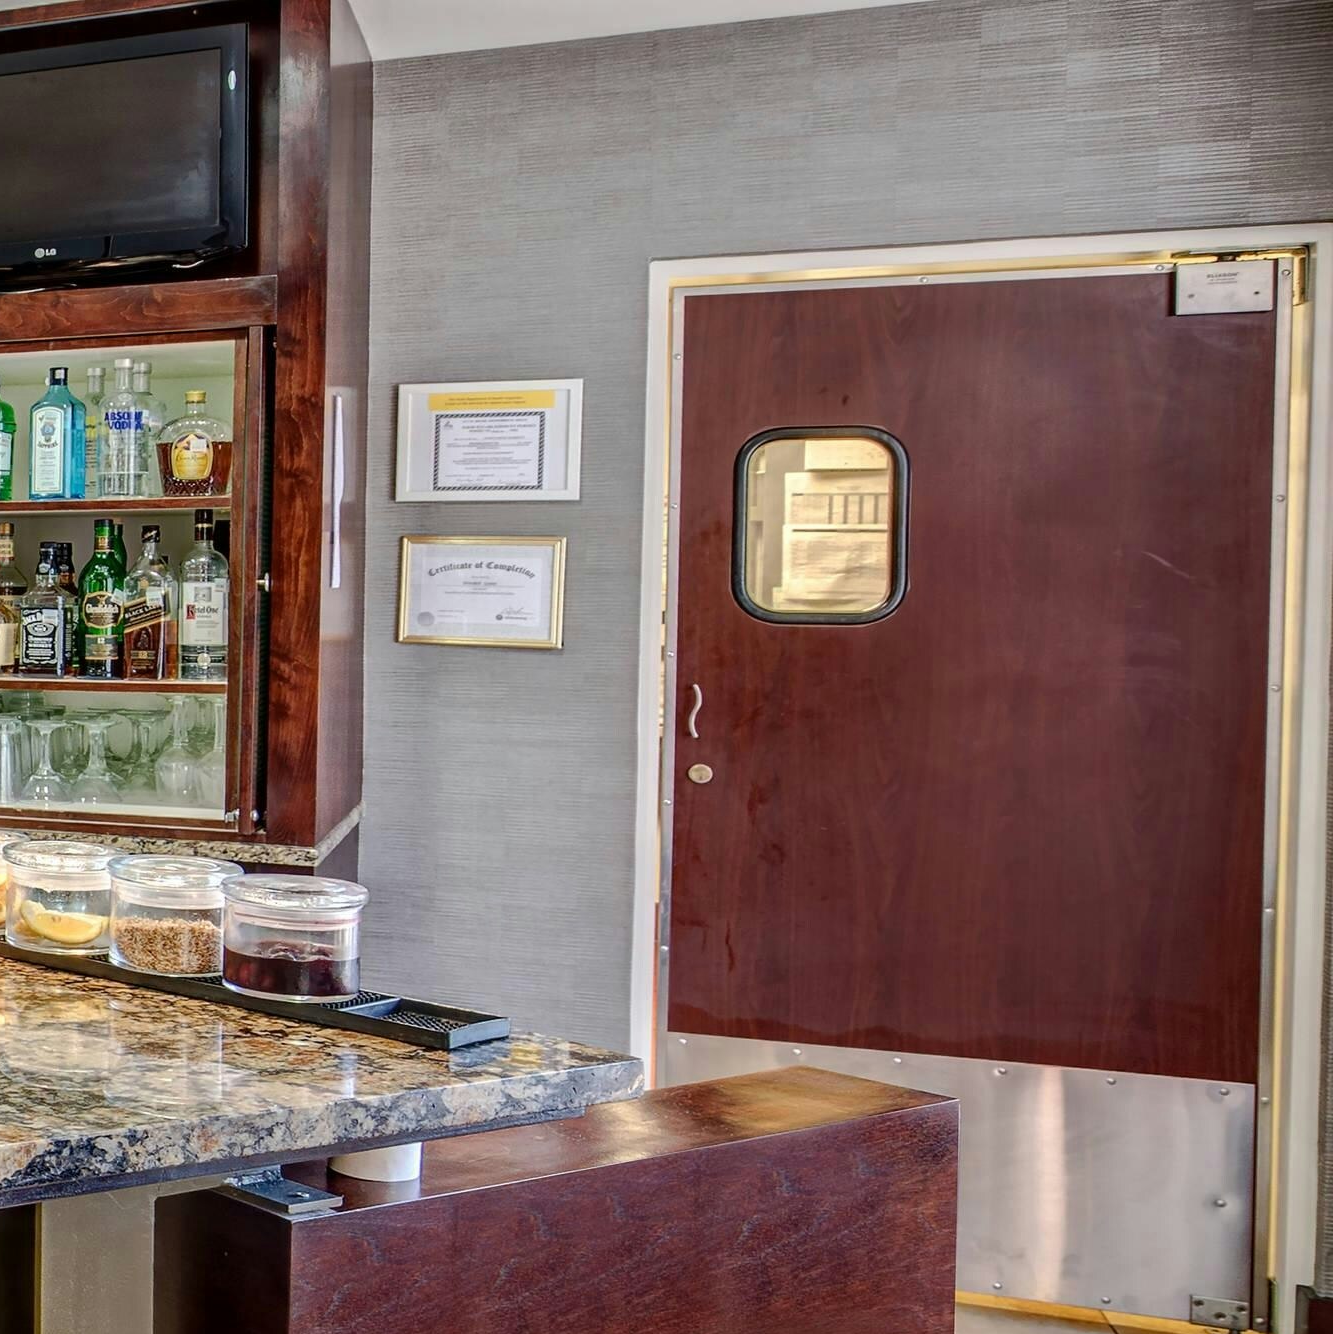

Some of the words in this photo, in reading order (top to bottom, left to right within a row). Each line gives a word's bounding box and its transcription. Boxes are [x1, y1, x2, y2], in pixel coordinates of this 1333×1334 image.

[45, 248, 57, 256] LG
[427, 562, 472, 577] Certificate
[474, 561, 483, 569] of
